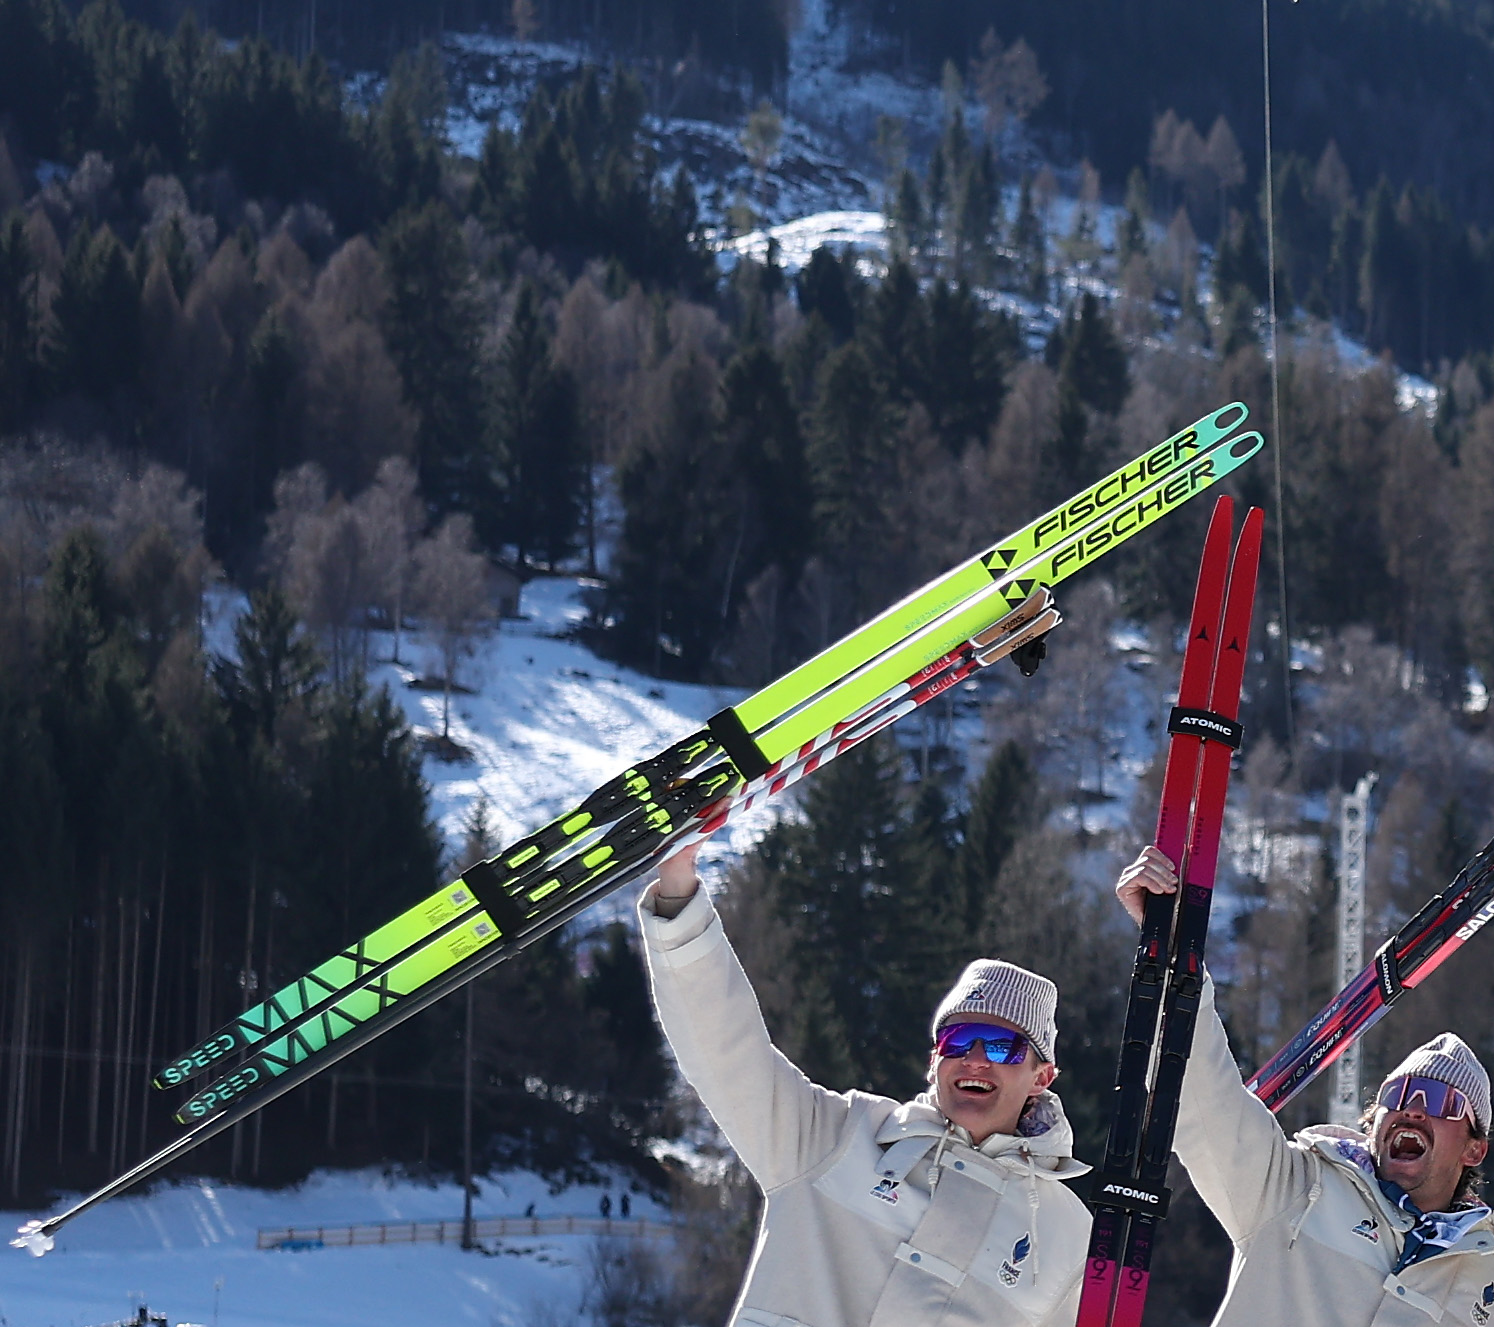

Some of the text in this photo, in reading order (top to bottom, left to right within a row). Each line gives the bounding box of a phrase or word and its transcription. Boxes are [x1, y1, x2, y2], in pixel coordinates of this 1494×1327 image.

[1034, 430, 1201, 548] FISCHER
[1052, 459, 1217, 576] FISCHER
[1180, 715, 1233, 738] ATOMIC
[1378, 953, 1391, 995] ALOMON
[165, 1034, 237, 1086] SPEED
[190, 1066, 261, 1119] SPEED
[1103, 1183, 1159, 1203] ATOMIC
